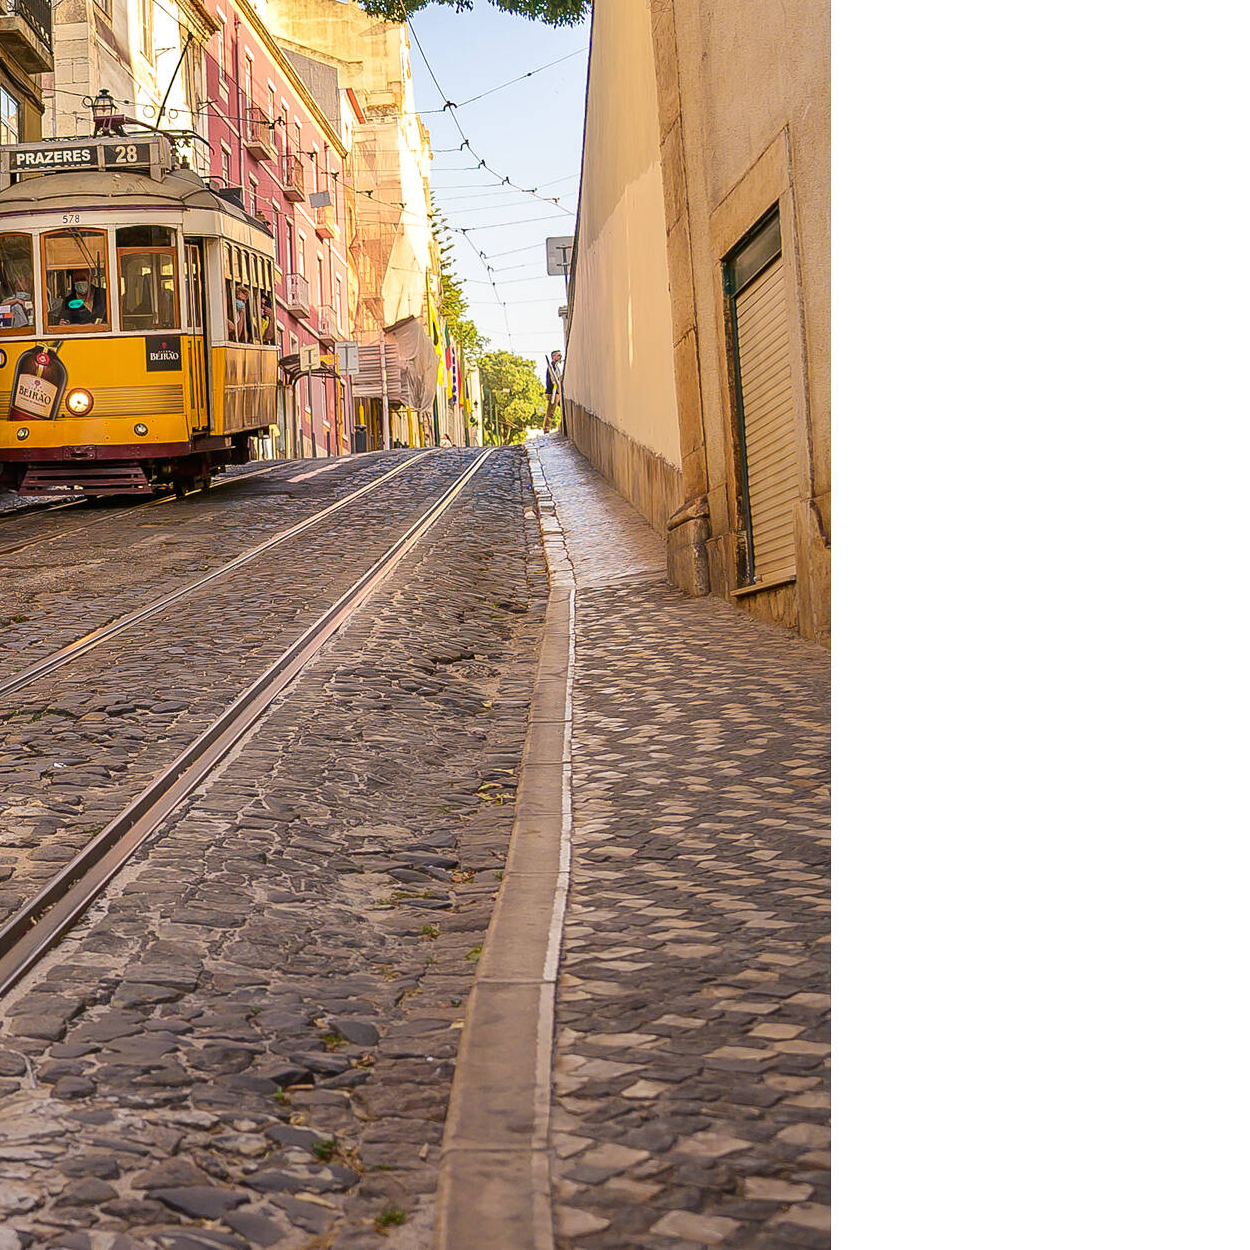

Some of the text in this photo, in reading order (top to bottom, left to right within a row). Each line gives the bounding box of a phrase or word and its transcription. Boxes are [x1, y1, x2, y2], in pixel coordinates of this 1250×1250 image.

[16, 145, 138, 166] PRAZERES 28
[62, 214, 80, 224] 578
